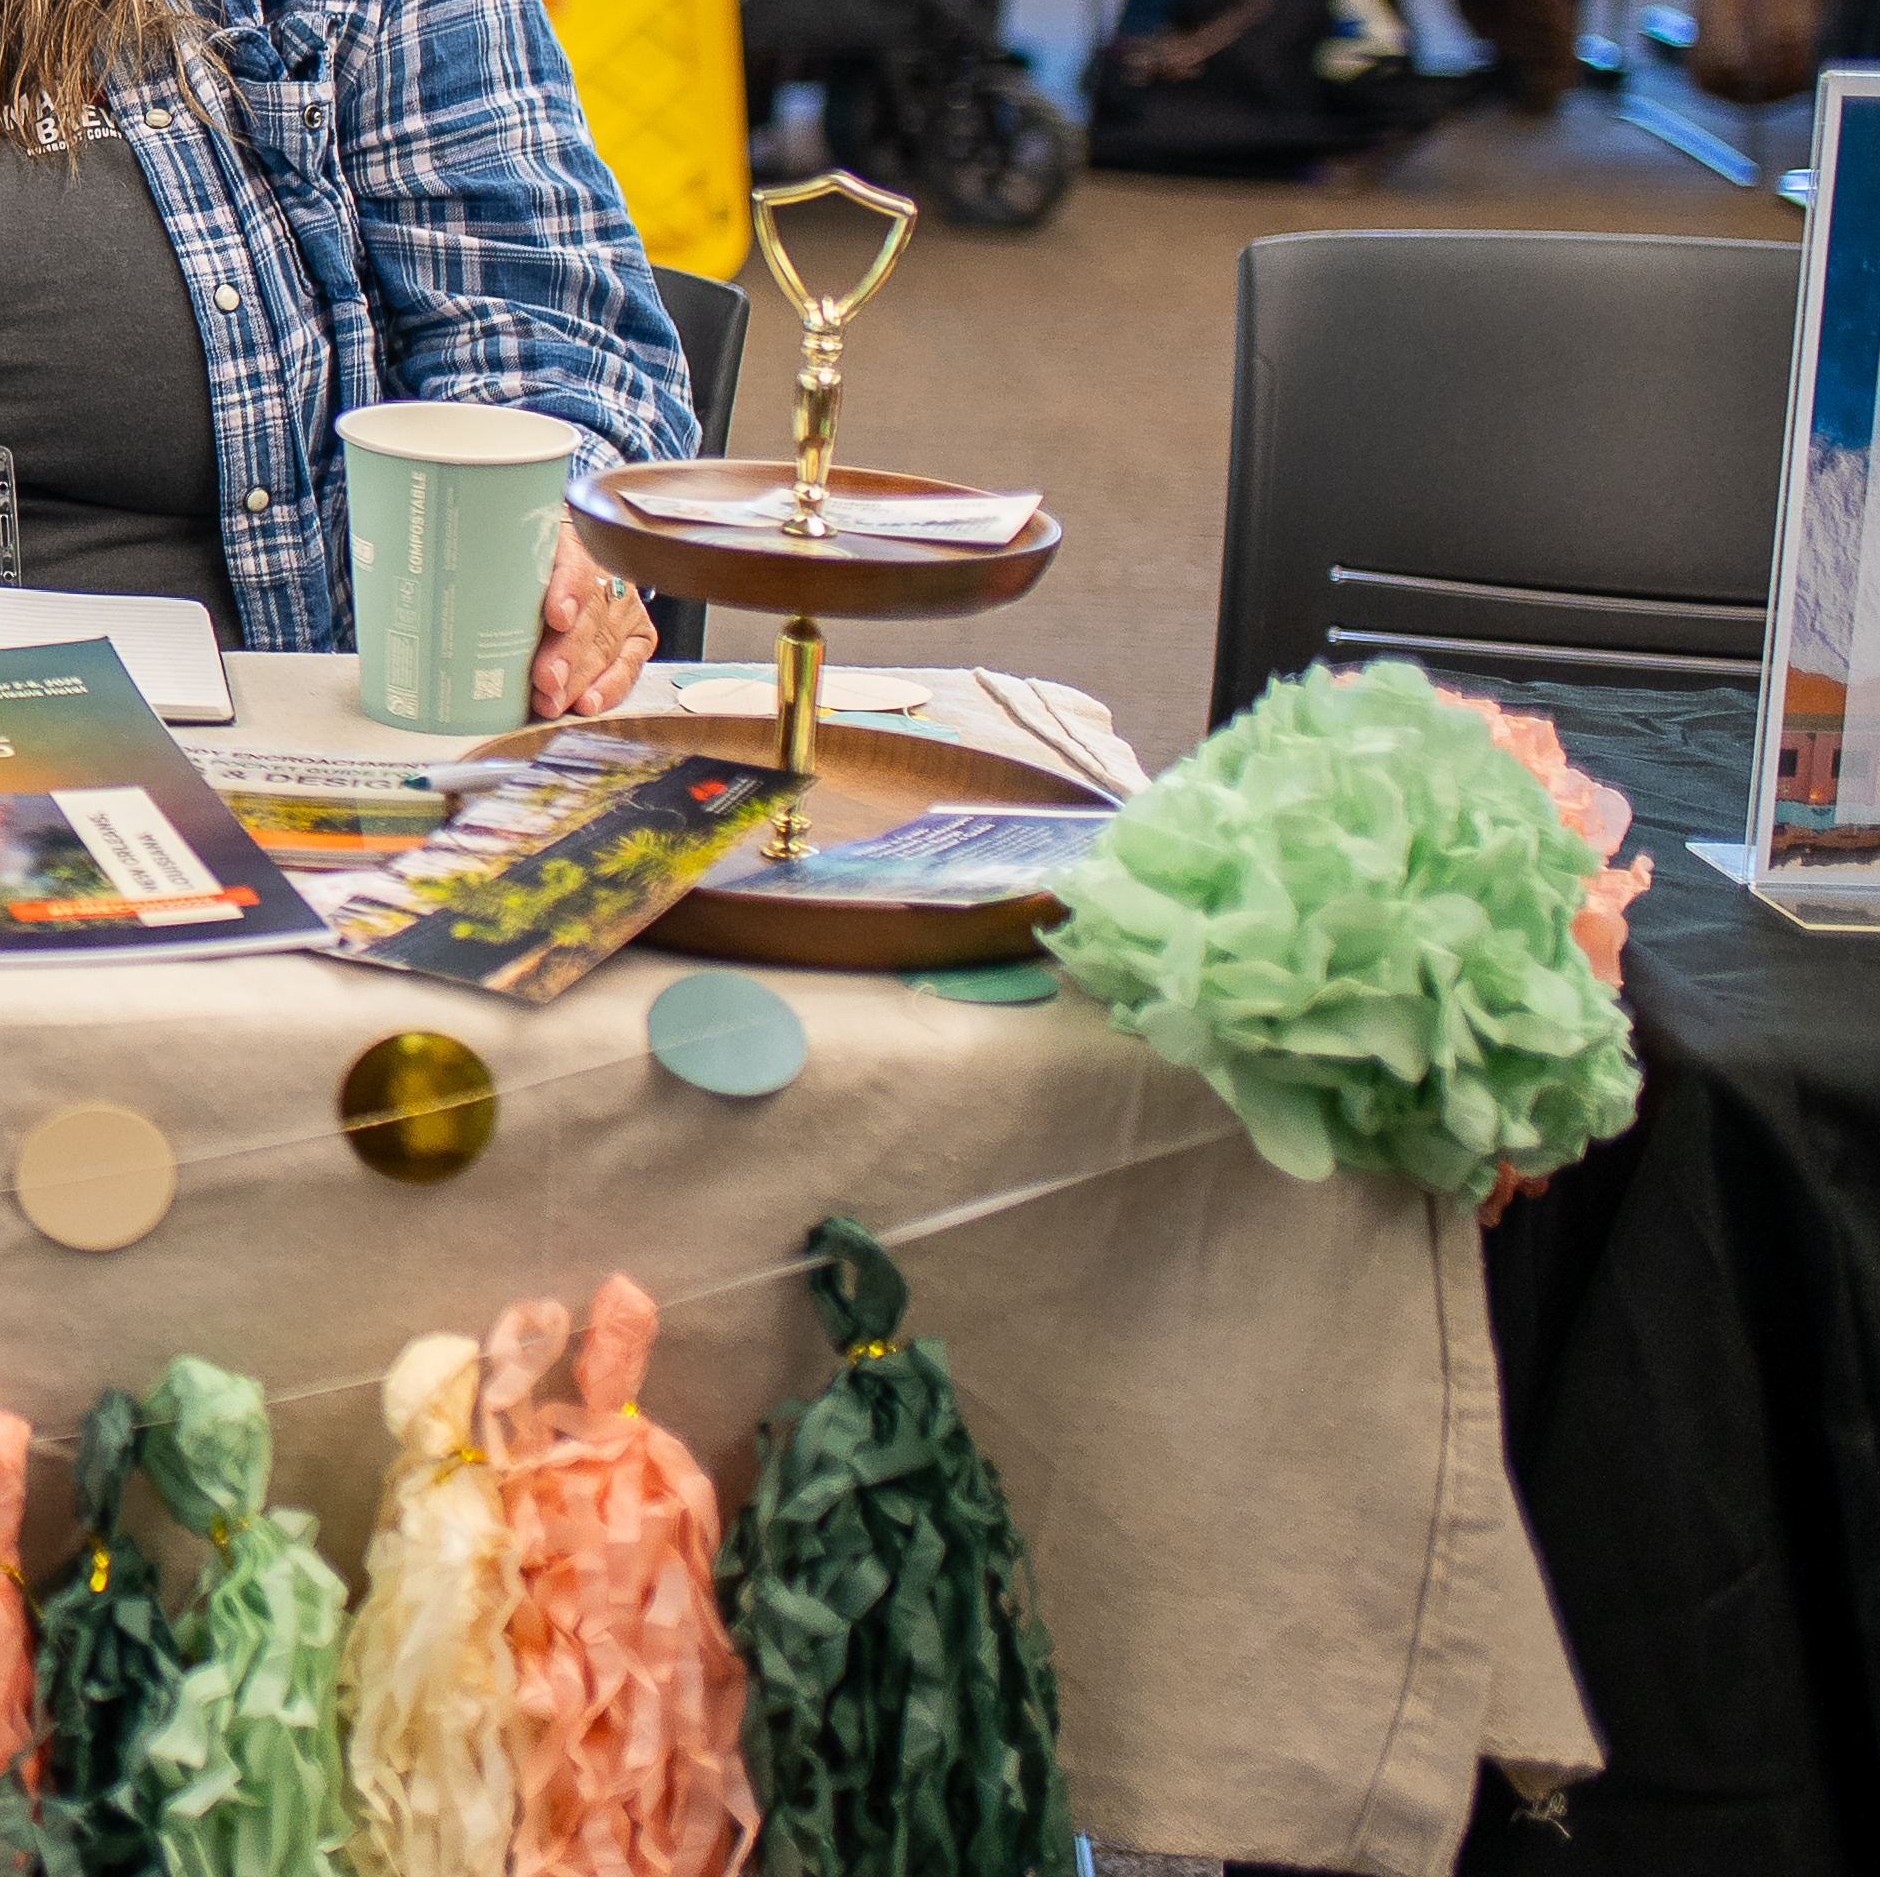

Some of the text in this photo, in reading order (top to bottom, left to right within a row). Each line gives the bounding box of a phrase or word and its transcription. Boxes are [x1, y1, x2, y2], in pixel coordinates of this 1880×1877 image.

[408, 471, 426, 575] COMPOSTABLE
[223, 769, 247, 780] &
[265, 772, 404, 790] DESIG
[231, 751, 431, 769] ENCROACHMENT
[87, 811, 159, 894] NEW ORLEANS
[138, 830, 196, 892] LOUISIANA
